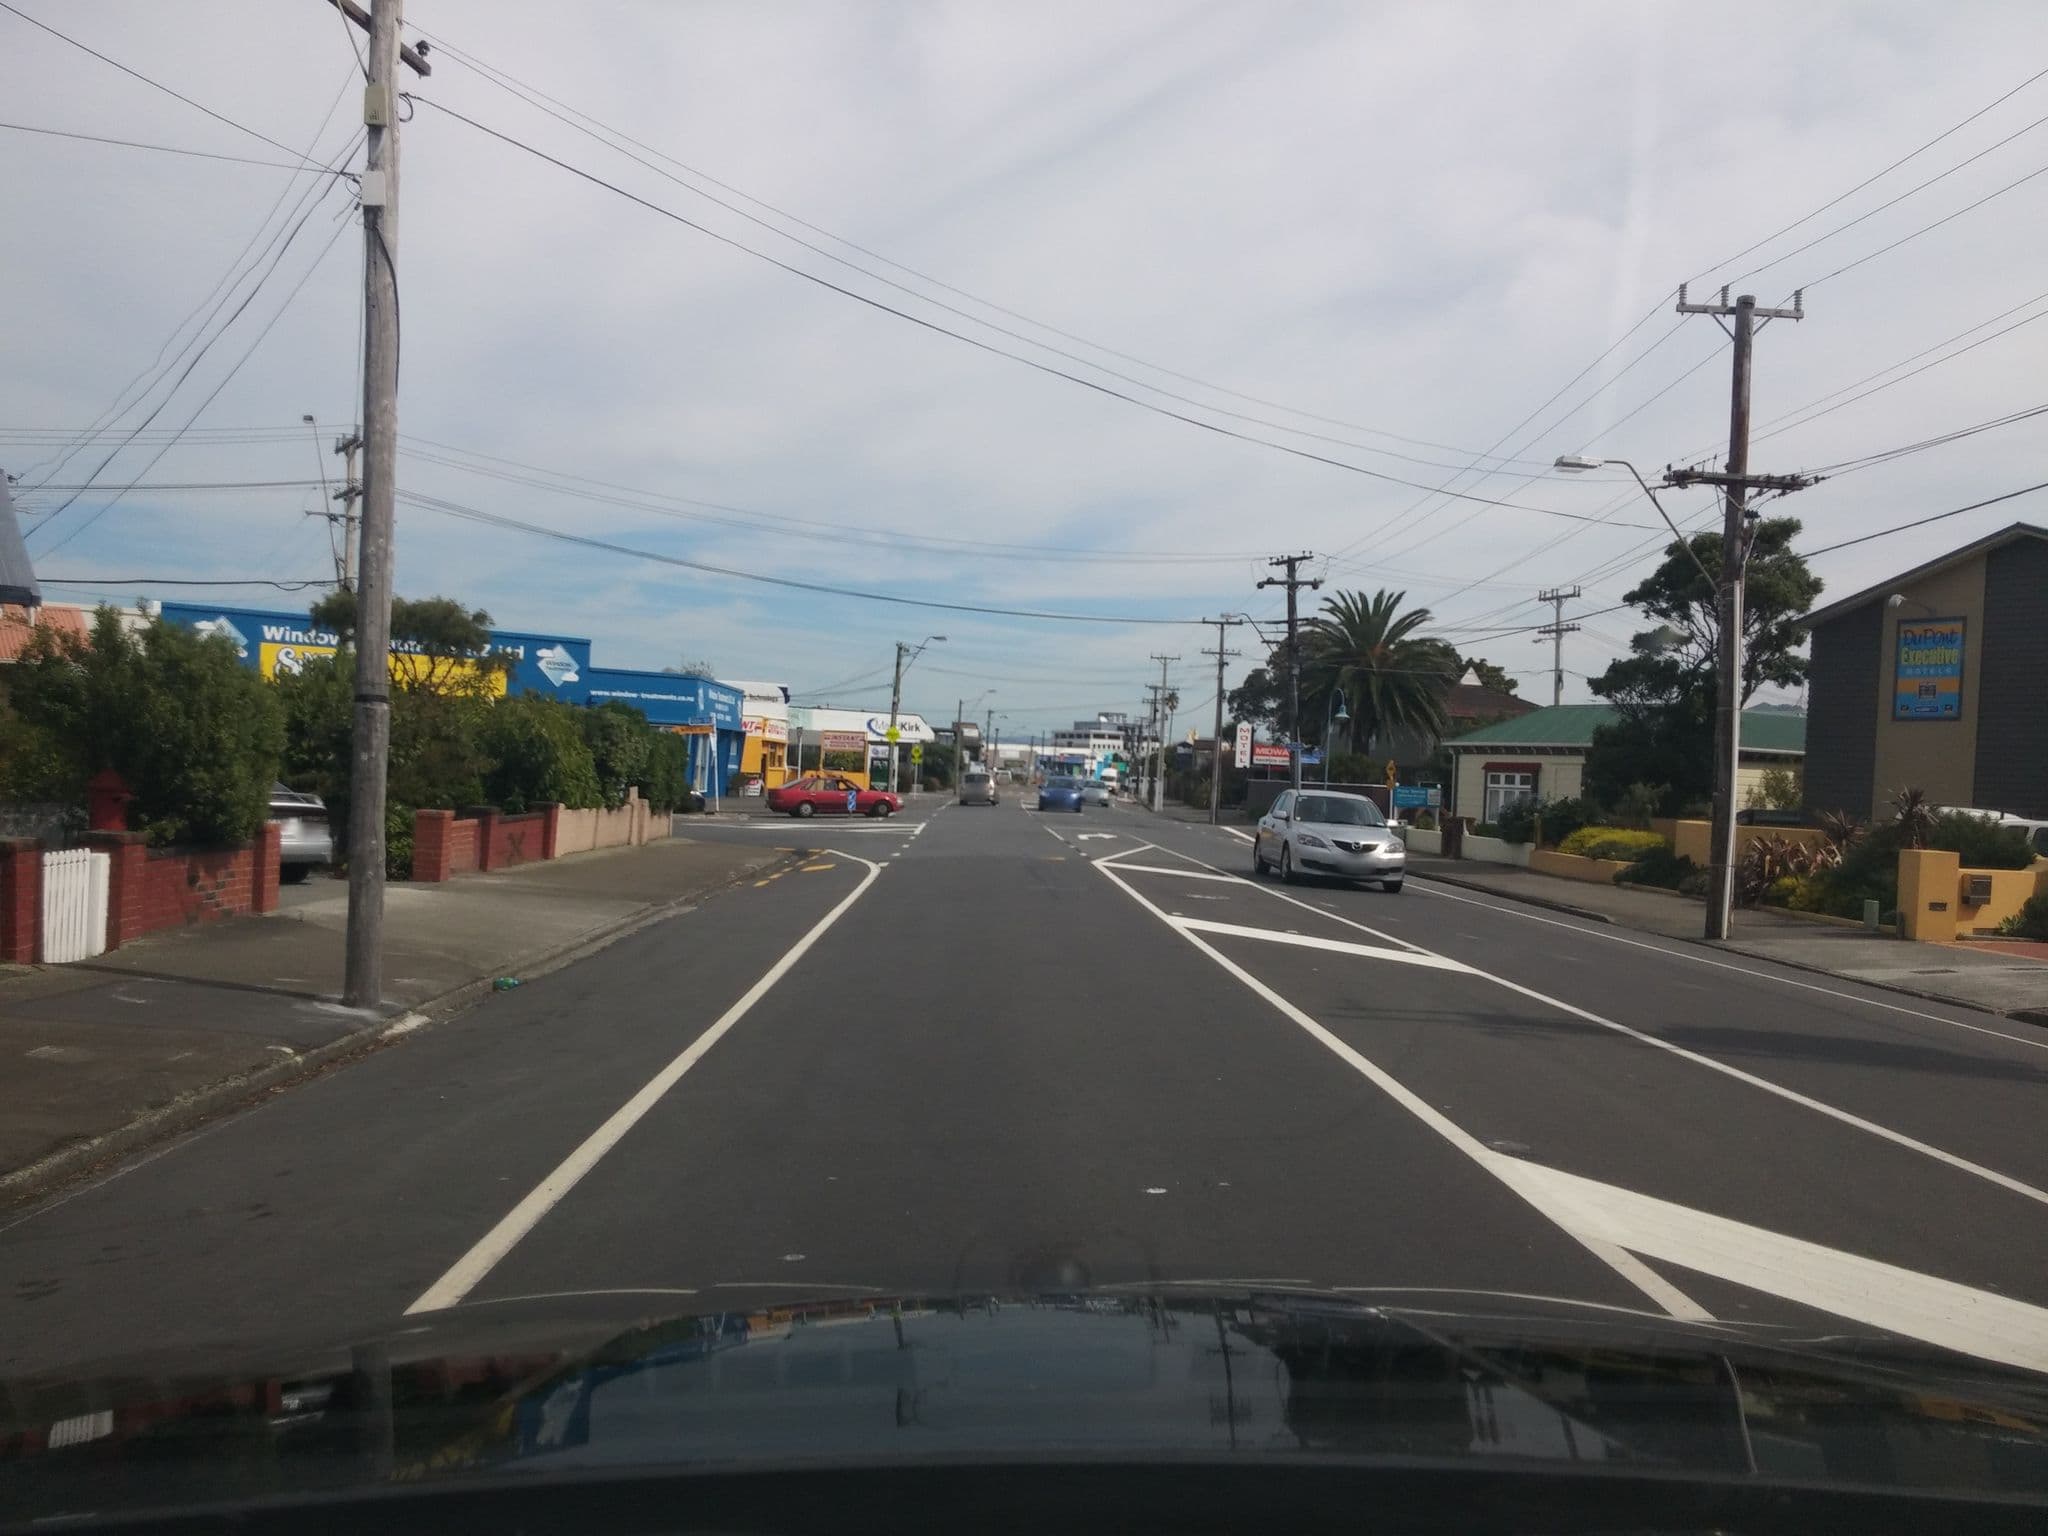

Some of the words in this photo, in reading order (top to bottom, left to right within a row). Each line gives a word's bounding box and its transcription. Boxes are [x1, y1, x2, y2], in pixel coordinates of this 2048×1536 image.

[1901, 646, 1959, 665] Executive
[1239, 727, 1250, 764] MOTEL
[1255, 745, 1290, 757] MIDWA
